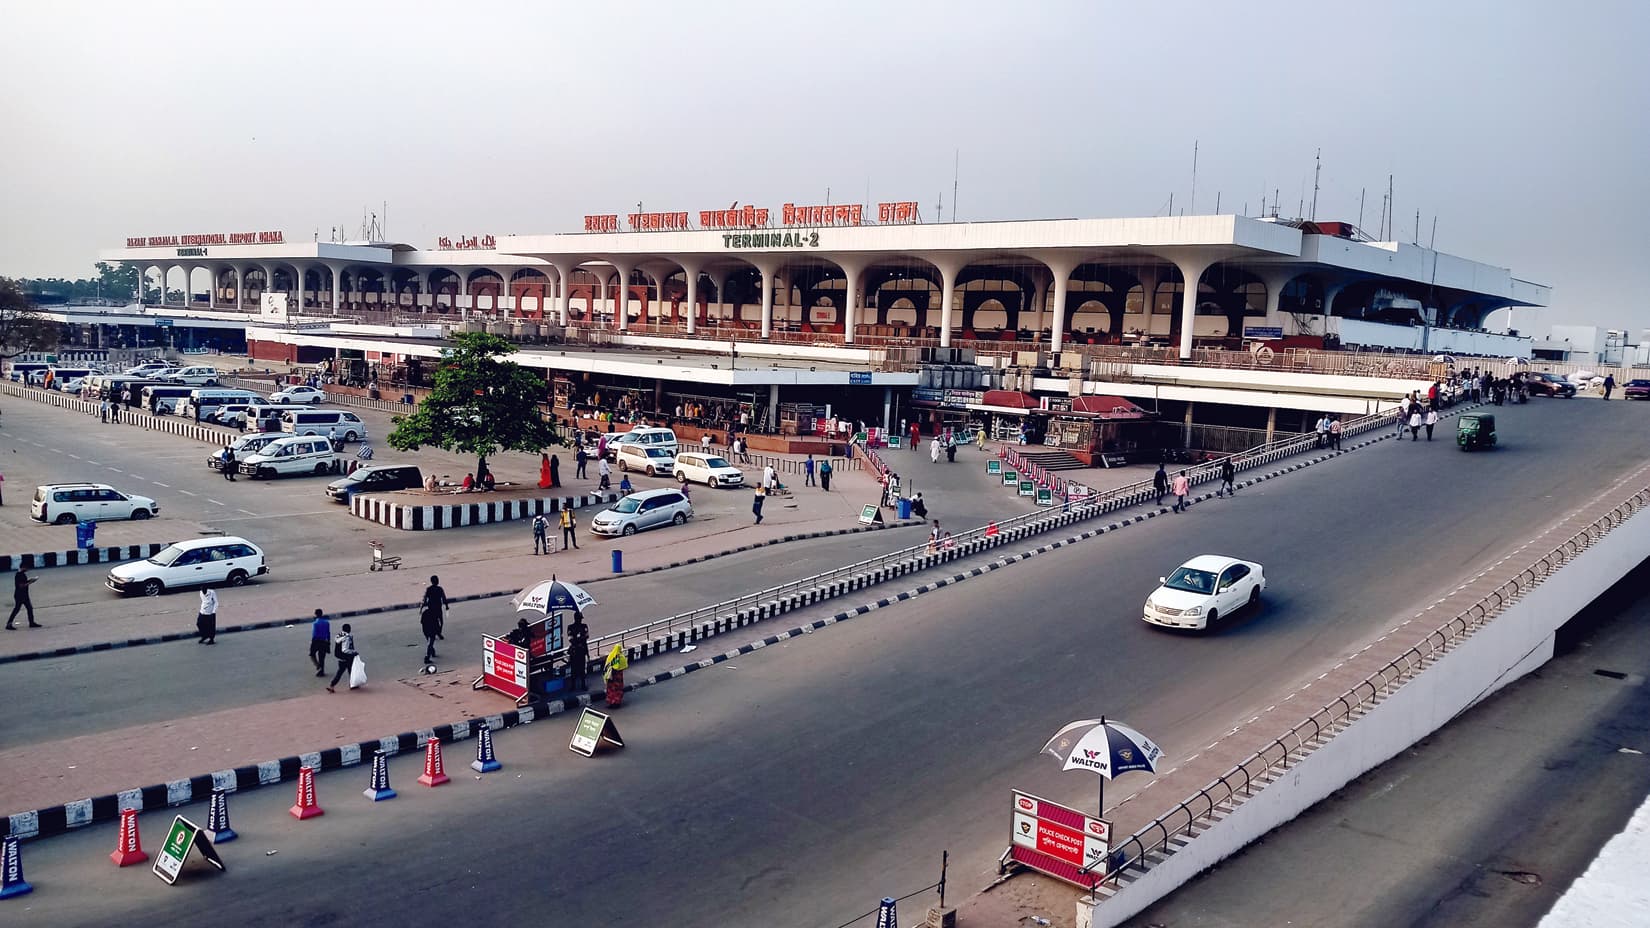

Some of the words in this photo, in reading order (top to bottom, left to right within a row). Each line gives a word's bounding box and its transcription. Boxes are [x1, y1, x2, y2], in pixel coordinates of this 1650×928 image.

[782, 203, 863, 227] বিমানবন্দর
[878, 201, 918, 223] ঢাকা
[722, 232, 819, 248] TERMINAL-2
[1071, 756, 1108, 770] WALTON
[305, 771, 313, 805] WALTON
[218, 793, 226, 829] WALTON
[127, 814, 136, 852] WALTON
[1039, 826, 1055, 837] POLICE
[1055, 832, 1071, 843] CHECK
[1070, 837, 1083, 847] POST
[8, 840, 18, 882] WALTON
